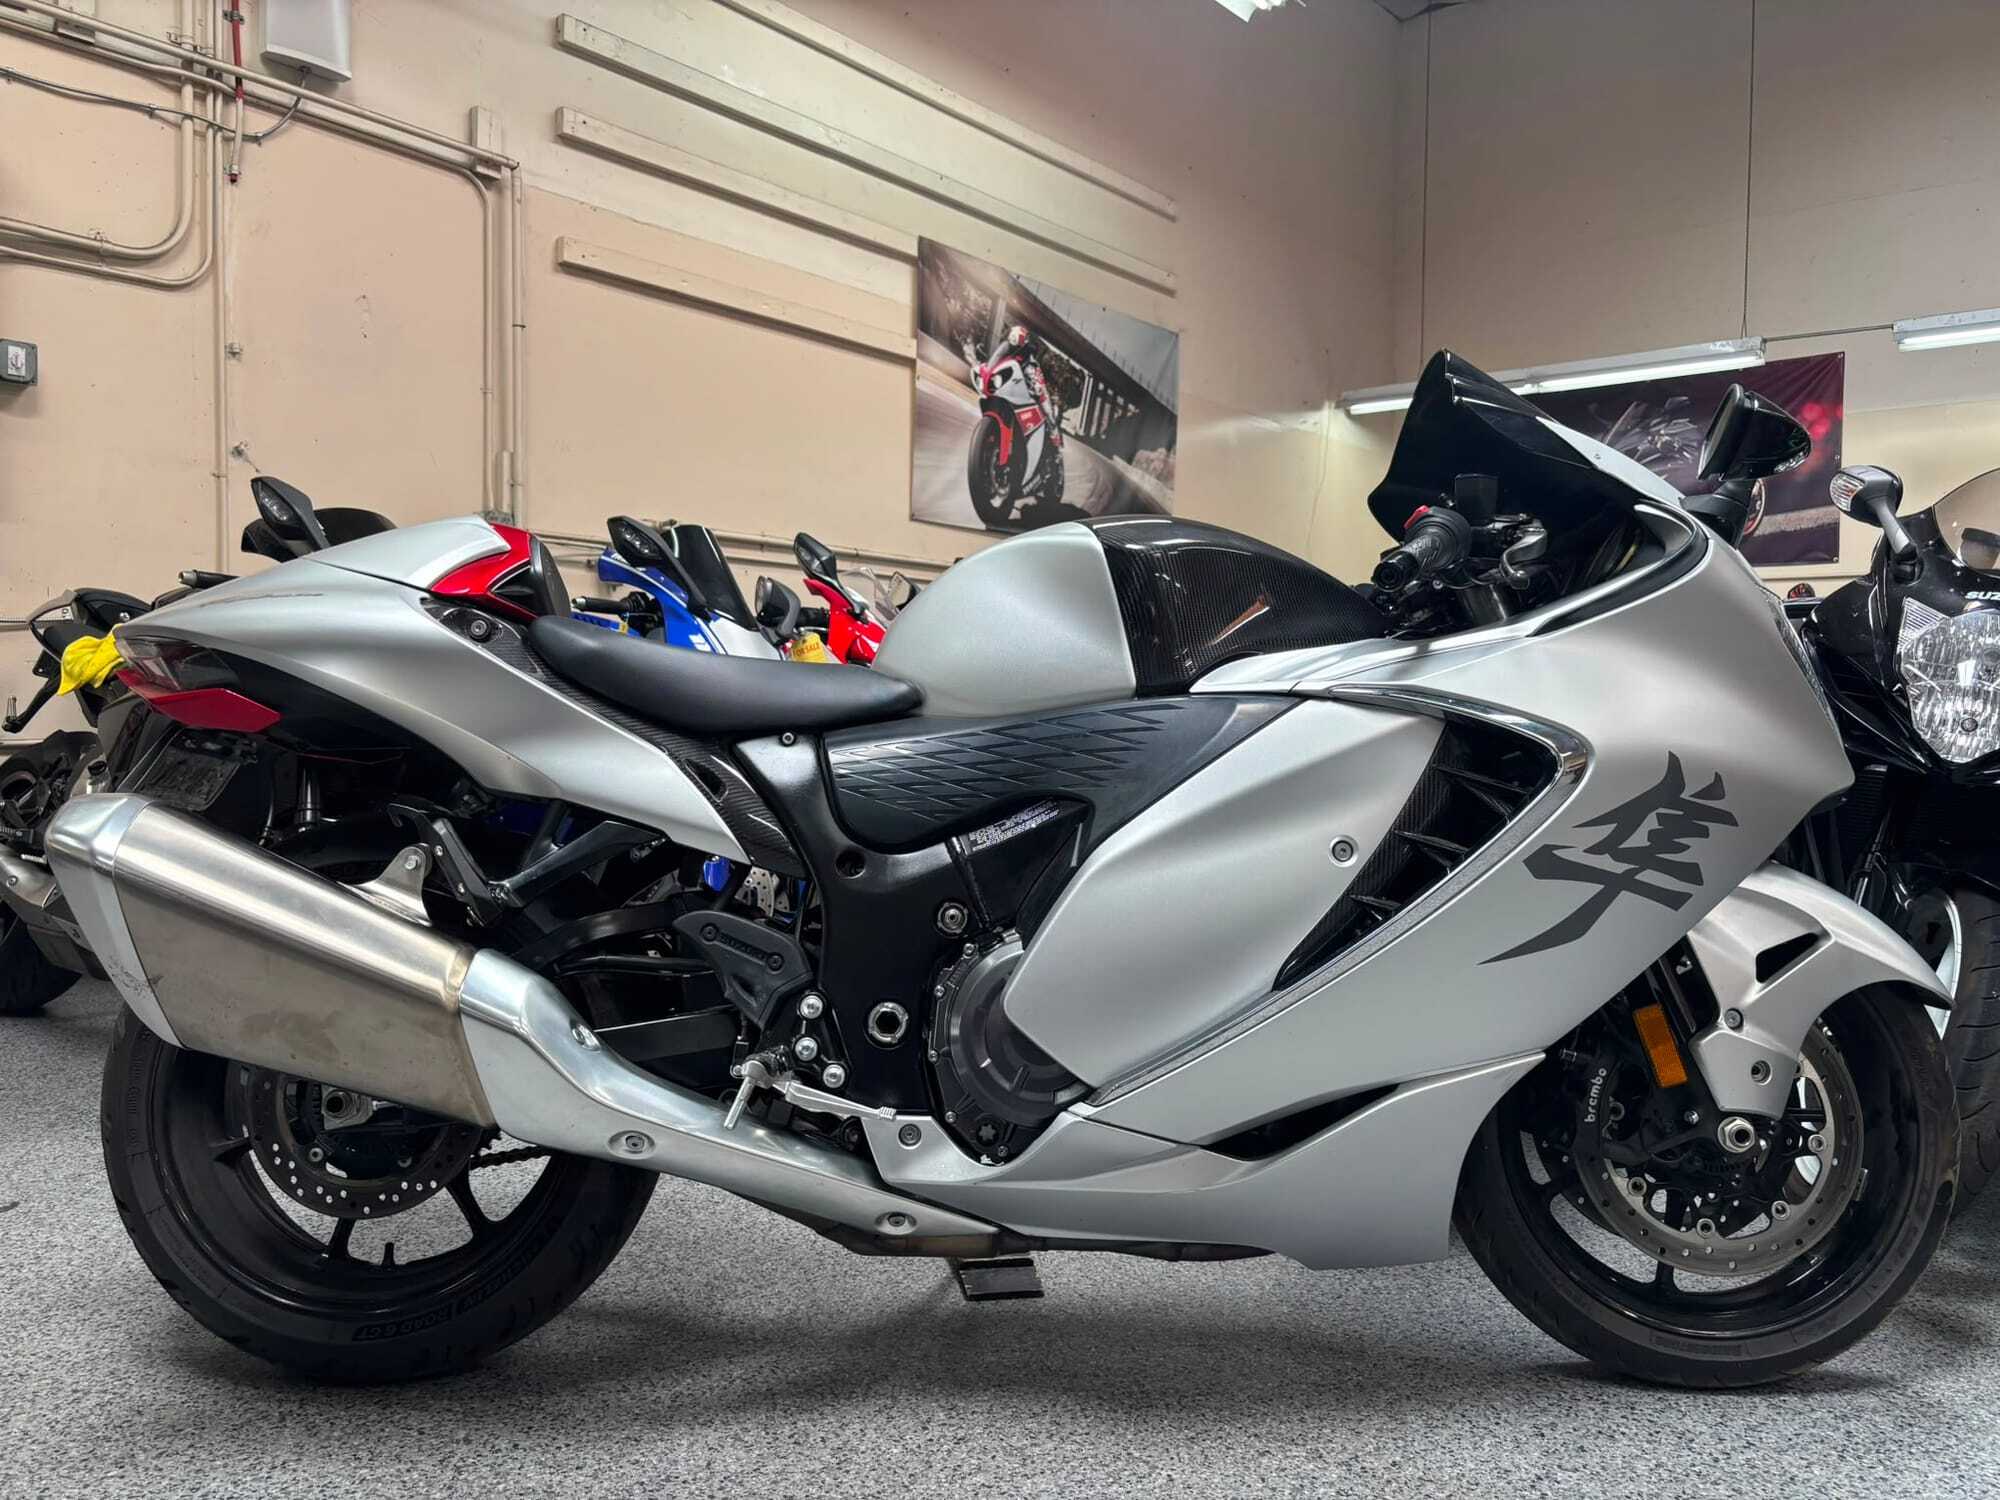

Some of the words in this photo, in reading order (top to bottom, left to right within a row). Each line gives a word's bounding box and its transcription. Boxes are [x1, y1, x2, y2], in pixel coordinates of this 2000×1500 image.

[805, 641, 821, 653] SALE
[1477, 750, 1739, 965] 隼
[1583, 1064, 1608, 1122] brembo
[399, 1303, 449, 1333] ROAD
[357, 1327, 383, 1340] GT
